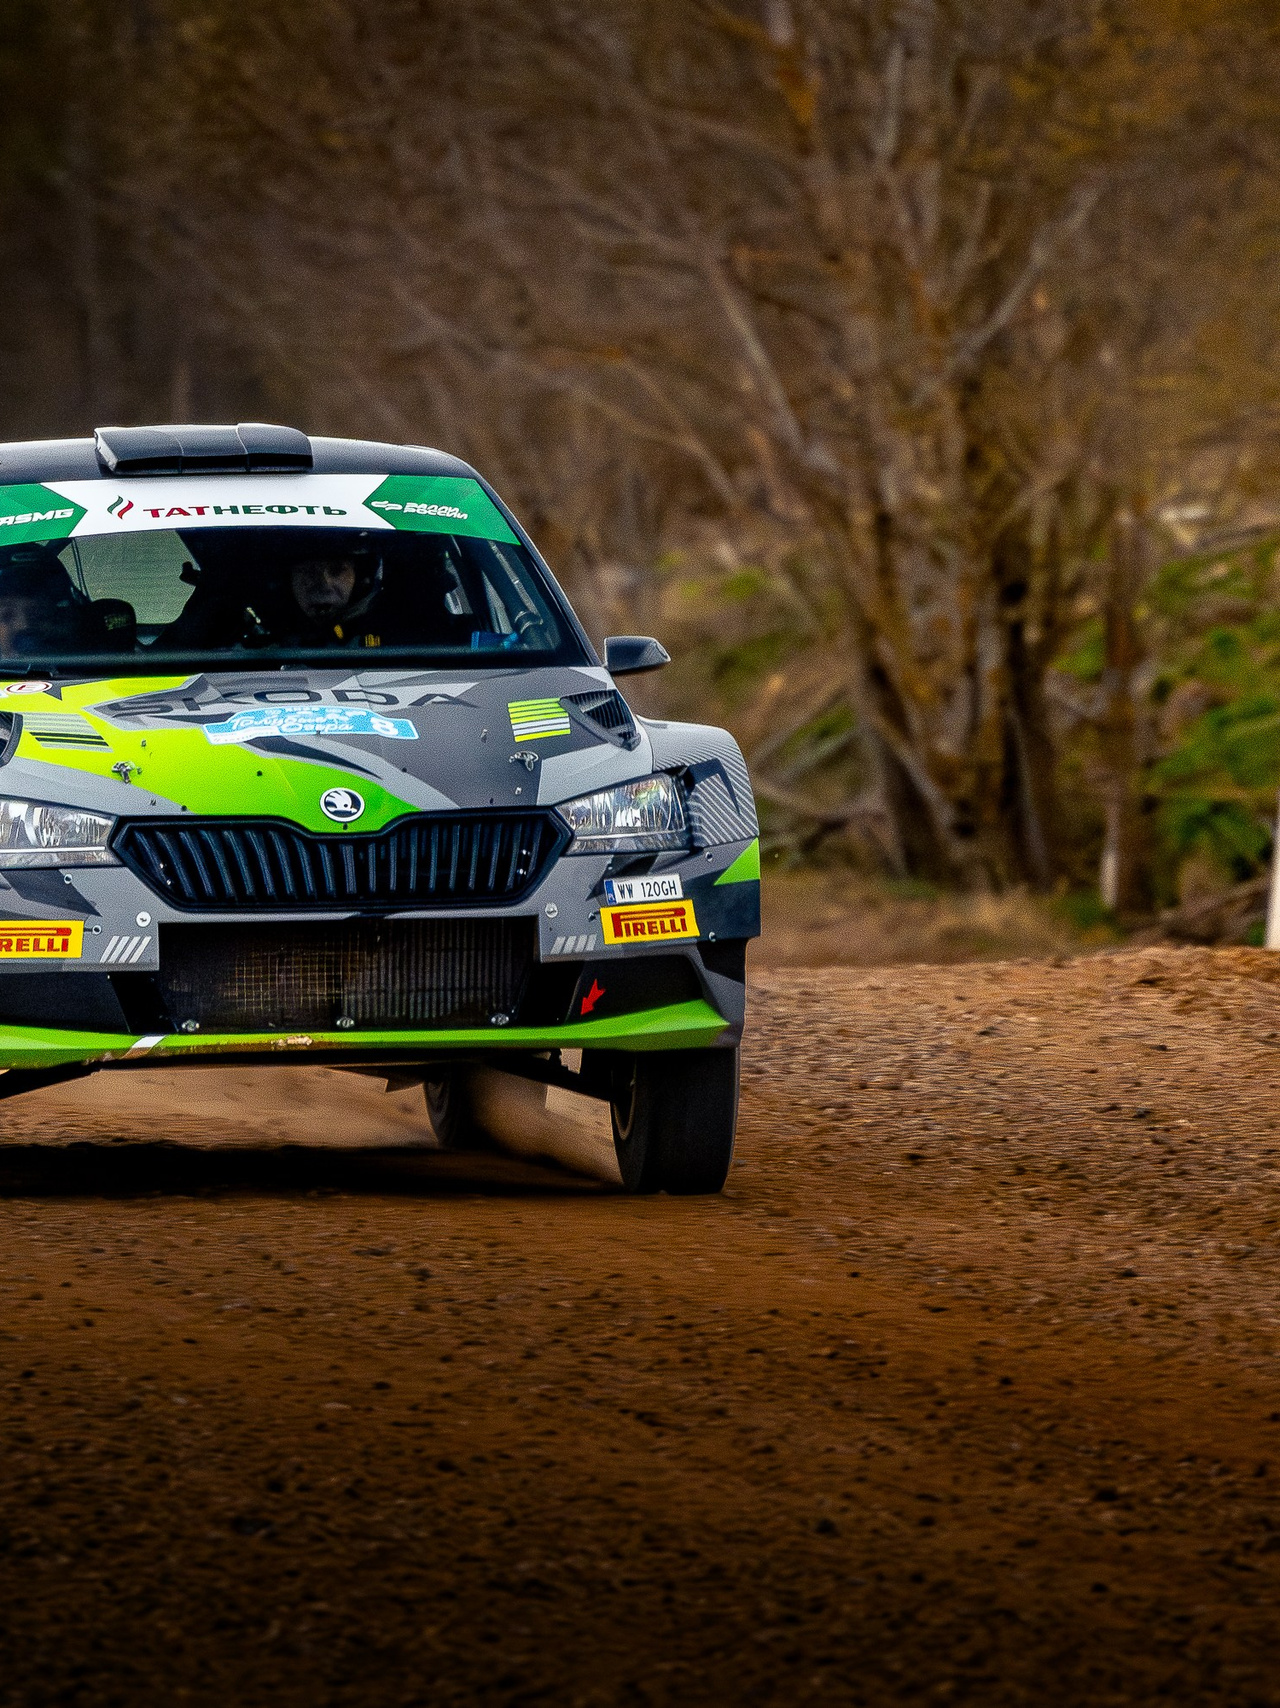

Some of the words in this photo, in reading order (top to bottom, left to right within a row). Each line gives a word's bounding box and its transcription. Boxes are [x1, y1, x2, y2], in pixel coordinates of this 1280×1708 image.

[143, 505, 347, 518] ТАТНЕФТЬ
[370, 717, 399, 736] 8
[617, 883, 634, 899] WW
[641, 880, 677, 898] 120GH
[611, 907, 688, 938] PIRELLI
